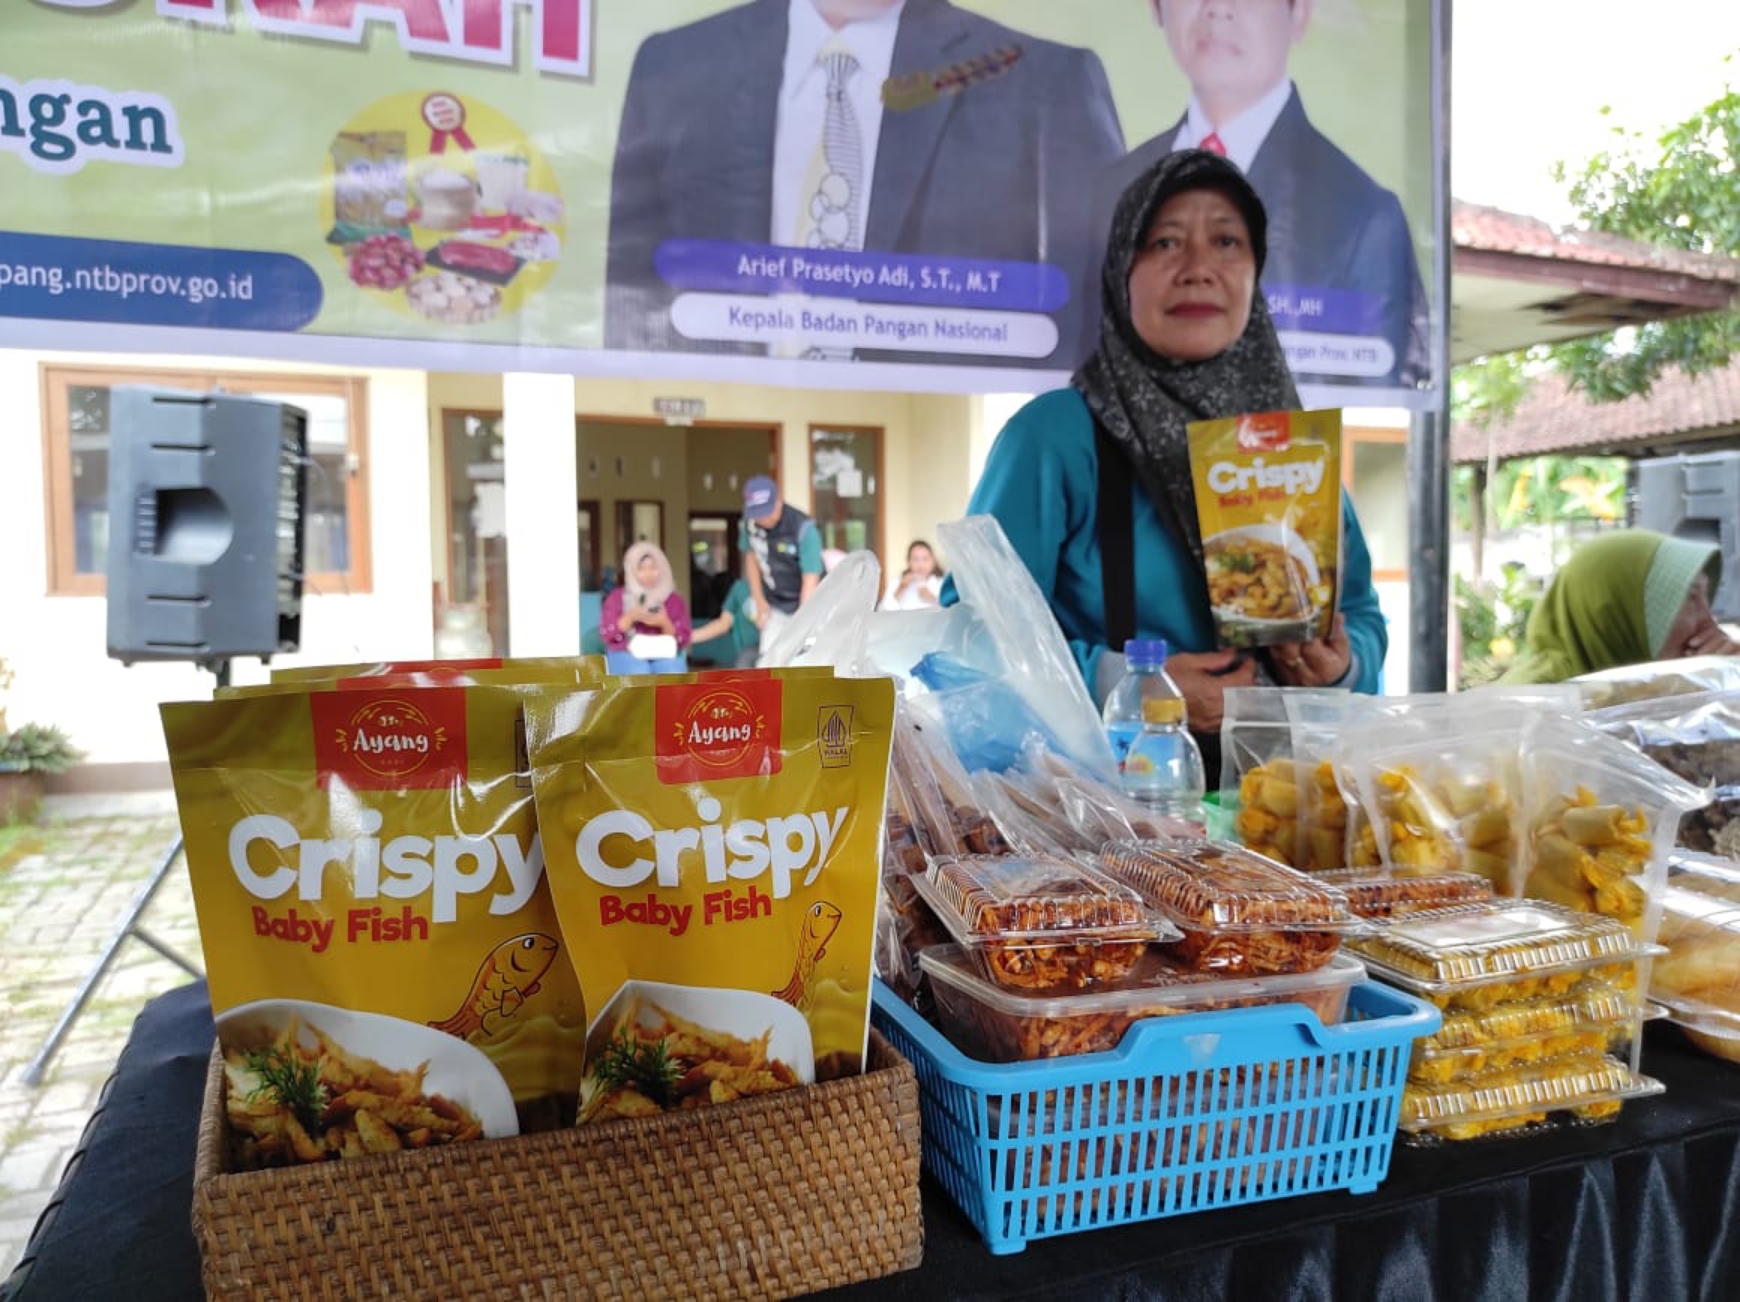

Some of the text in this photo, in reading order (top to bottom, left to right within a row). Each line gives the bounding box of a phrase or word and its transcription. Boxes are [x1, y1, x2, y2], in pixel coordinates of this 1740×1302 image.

[737, 255, 786, 278] Arief
[792, 260, 874, 289] Prasetyo
[878, 266, 915, 290] Adi,
[967, 271, 1001, 293] M.T
[728, 308, 1008, 342] Kepala Badan Pangan Nasional
[1207, 455, 1325, 494] Crispy
[353, 727, 429, 753] Ayang
[687, 720, 751, 745] Ayang
[228, 810, 544, 923] Crispy
[576, 798, 849, 899] Crispy
[252, 906, 429, 952] Baby Fish
[600, 886, 772, 936] Baby Fish
